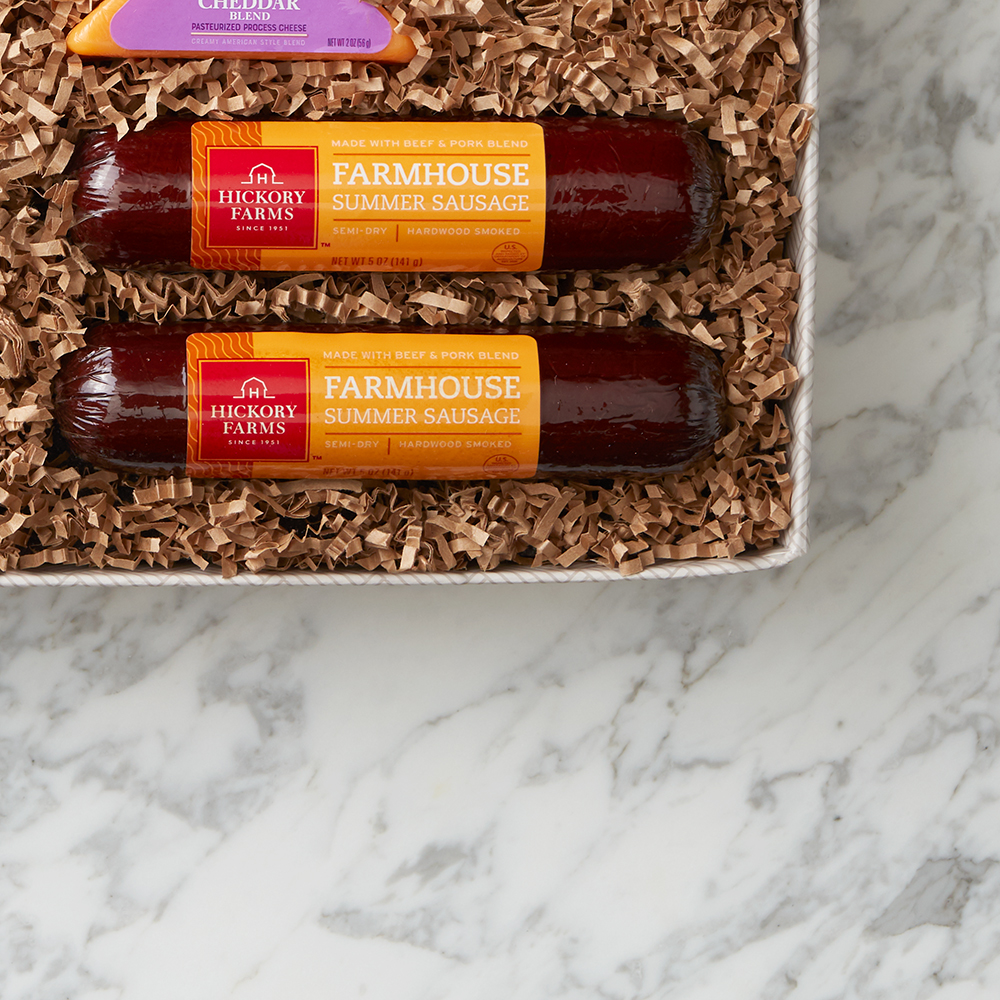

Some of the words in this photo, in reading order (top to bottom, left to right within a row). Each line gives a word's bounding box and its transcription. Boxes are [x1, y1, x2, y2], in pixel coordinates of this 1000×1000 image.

[230, 12, 270, 20] BLEND
[192, 23, 240, 31] PASTEURIZED
[279, 24, 307, 32] CHEESE
[331, 139, 365, 147] MADE
[450, 140, 484, 148] PORK
[488, 140, 528, 148] BLEND
[333, 163, 529, 185] FARMHOUSE
[219, 190, 306, 204] HICKORY
[333, 194, 426, 211] SUMMER
[432, 195, 529, 211] SAUSAGE
[231, 208, 294, 220] FARMS
[333, 227, 388, 235] SEMI-DRY
[331, 257, 348, 265] NET
[351, 257, 366, 266] WT
[368, 257, 374, 265] 5
[376, 257, 388, 266] OZ
[390, 257, 410, 266] (141
[413, 258, 423, 267] g)
[323, 351, 358, 359] MADE
[361, 351, 392, 359] WITH
[395, 351, 426, 359] BEEF
[479, 352, 519, 360] BLEND
[324, 375, 521, 399] FARMHOUSE
[211, 405, 297, 418] HICKORY
[325, 408, 417, 424] SUMMER
[423, 408, 521, 424] SAUSAGE
[223, 422, 286, 435] FARMS
[325, 440, 379, 448] SEMI-DRY
